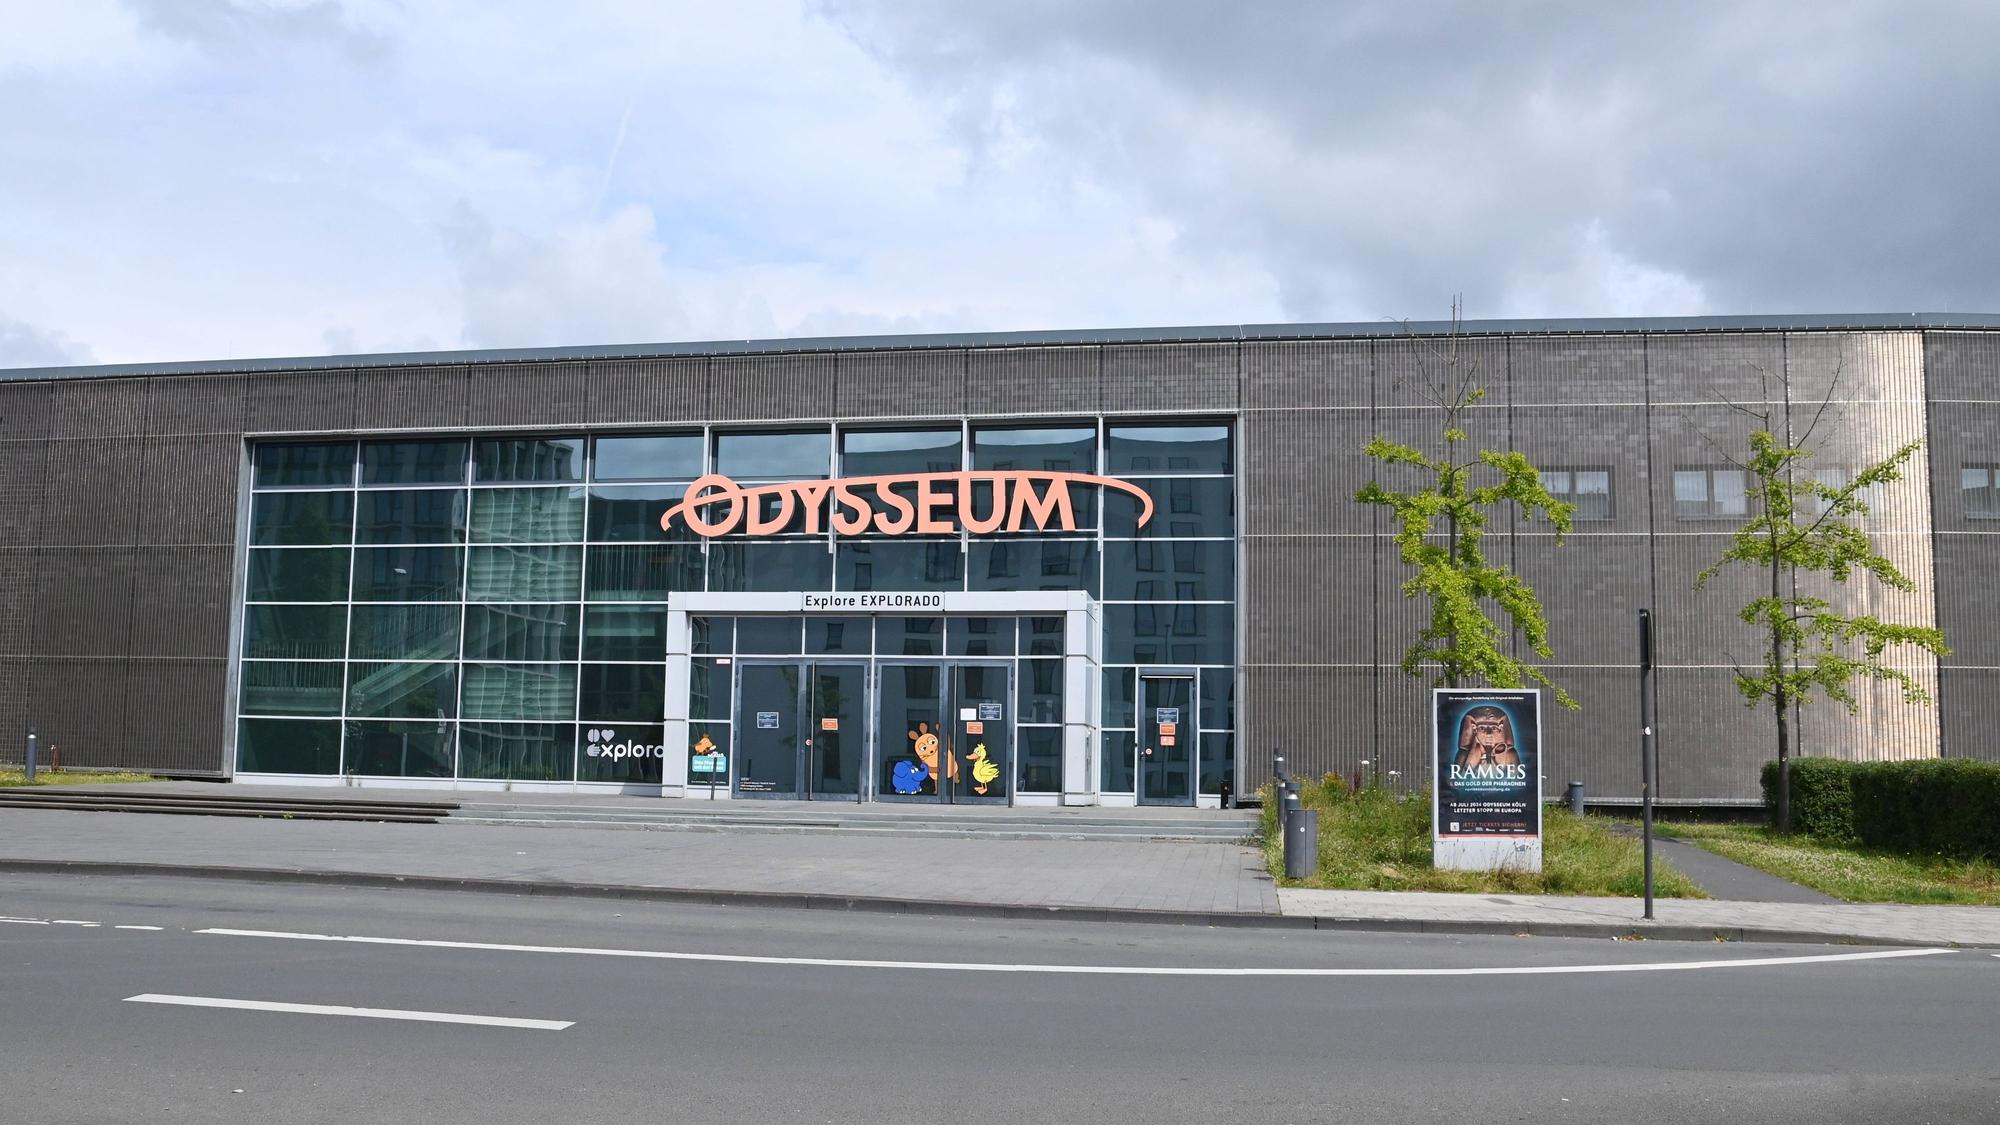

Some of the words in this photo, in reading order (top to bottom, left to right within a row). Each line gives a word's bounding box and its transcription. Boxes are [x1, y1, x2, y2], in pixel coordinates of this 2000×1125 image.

[660, 471, 1154, 537] ODYSSEUM
[805, 595, 856, 609] Explore
[861, 595, 940, 606] EXPLORADO
[1450, 764, 1526, 780] RAMSES
